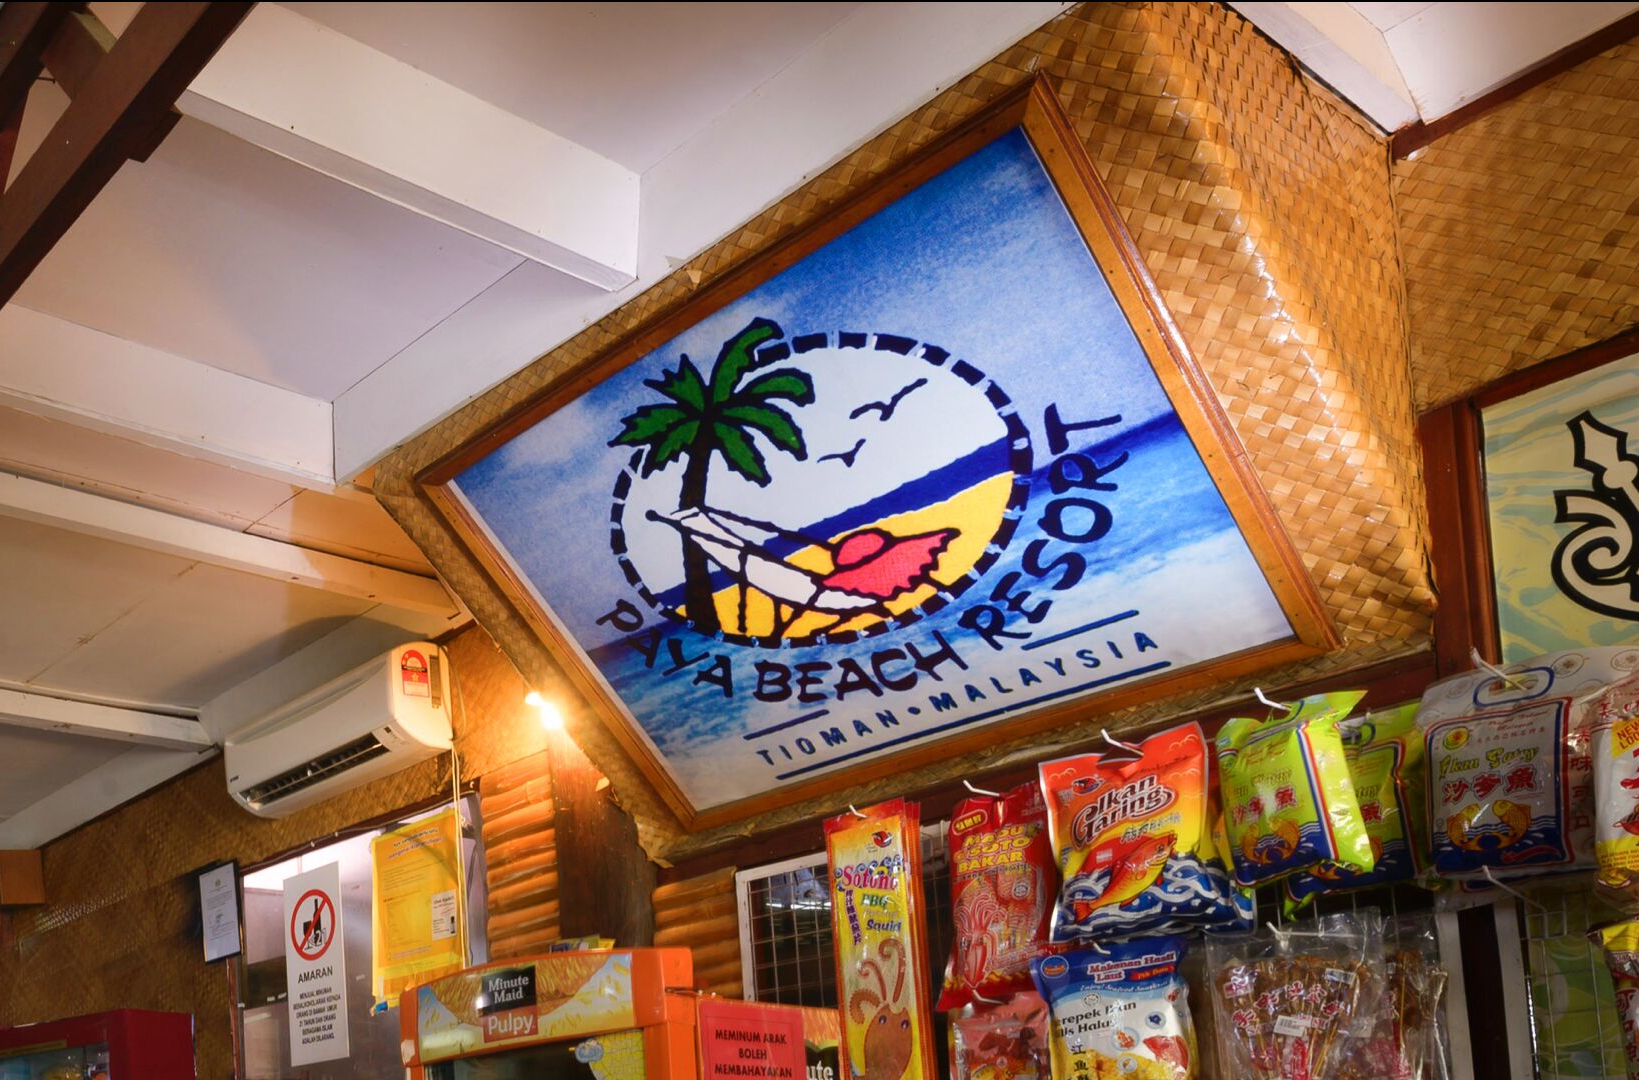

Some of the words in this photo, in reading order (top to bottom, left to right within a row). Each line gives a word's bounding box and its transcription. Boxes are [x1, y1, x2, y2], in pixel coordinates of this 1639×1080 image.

[596, 599, 732, 697] PAYA
[753, 631, 969, 703] BEACH
[960, 403, 1129, 651] RESORT
[757, 709, 899, 766] TIOMAN
[928, 631, 1159, 713] MALAYSIA
[297, 966, 333, 984] AMARAN
[487, 974, 530, 993] Minute
[493, 987, 524, 1004] Maid
[487, 1013, 533, 1037] Pulpy
[715, 1029, 761, 1043] MEMINUM
[763, 1033, 787, 1045] ARAK
[738, 1048, 767, 1060] BOLEH
[714, 1064, 793, 1079] MEMBAHAYAKAN
